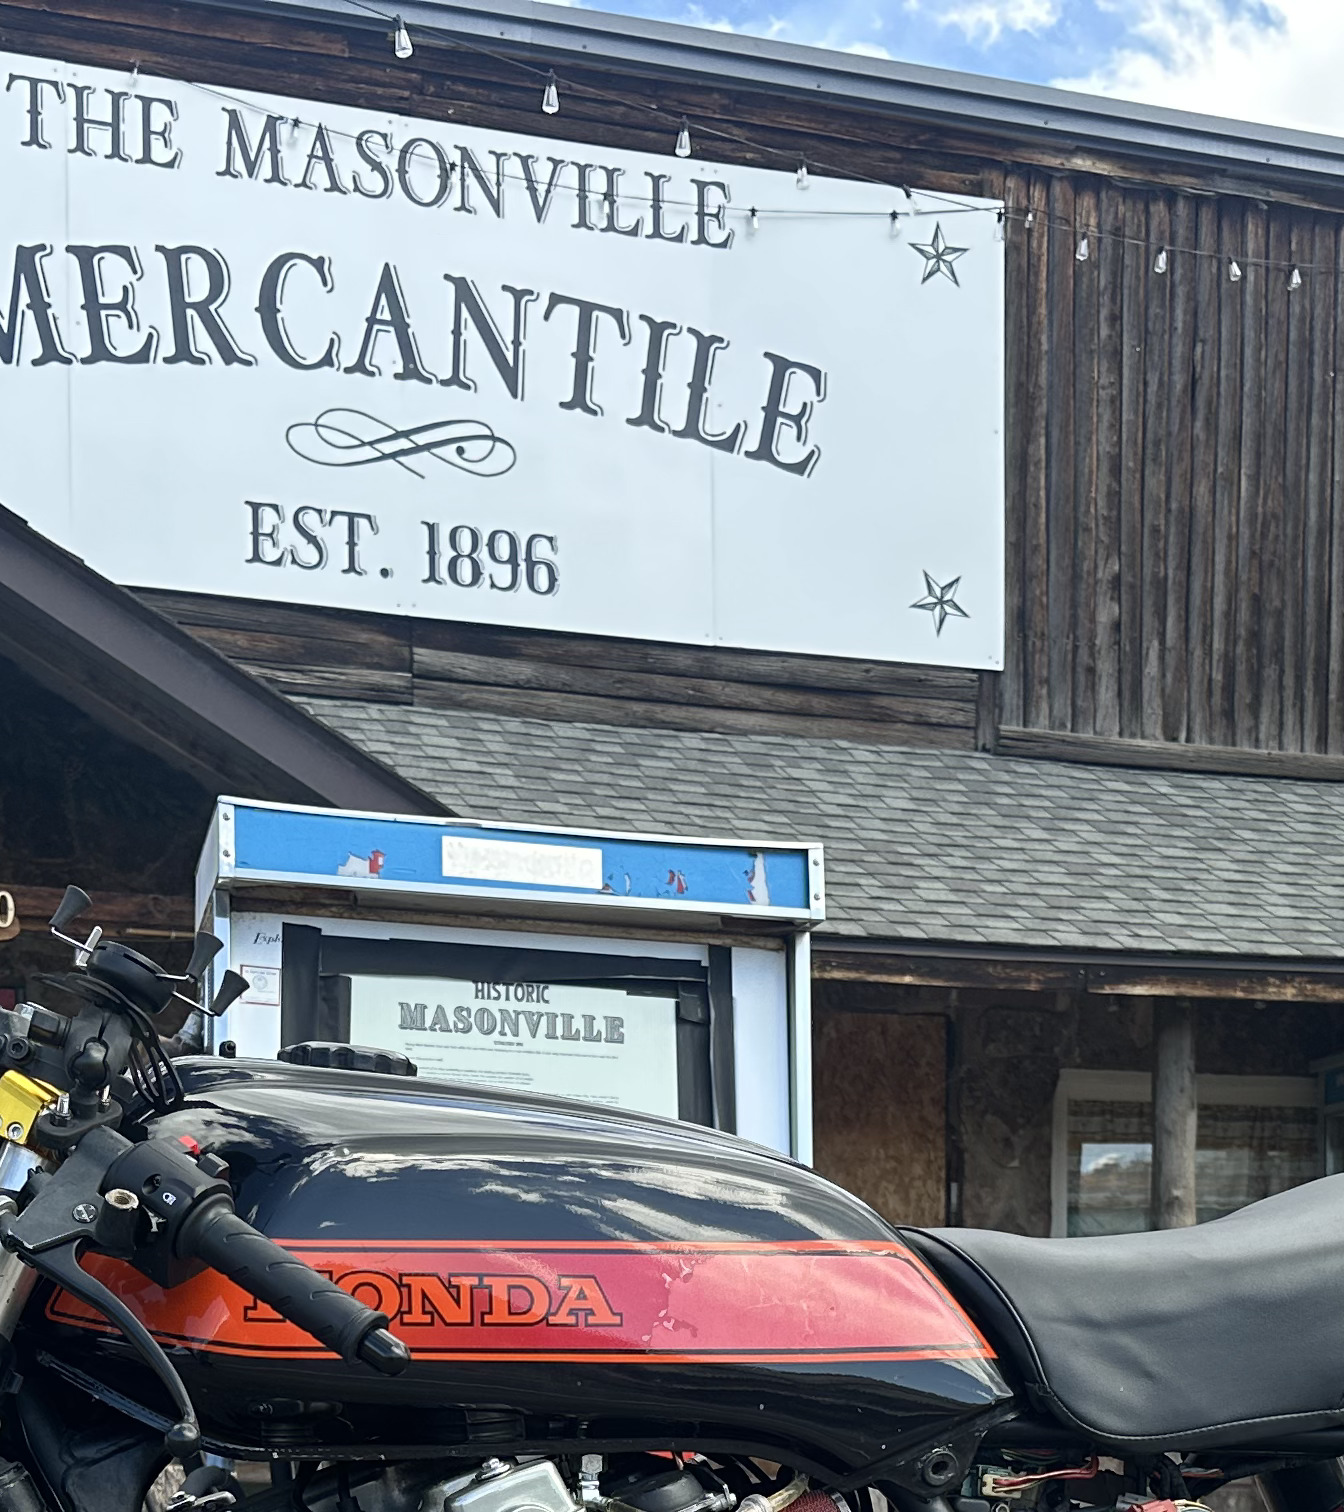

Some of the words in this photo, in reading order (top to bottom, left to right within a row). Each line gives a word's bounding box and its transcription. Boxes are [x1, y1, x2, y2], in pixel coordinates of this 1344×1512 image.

[6, 73, 183, 171] THE
[216, 106, 735, 250] MASONVILLE
[244, 499, 393, 579] EST.
[420, 520, 560, 597] 1896
[398, 1002, 625, 1045] MASONVILLE
[473, 982, 551, 1004] HISTORIC
